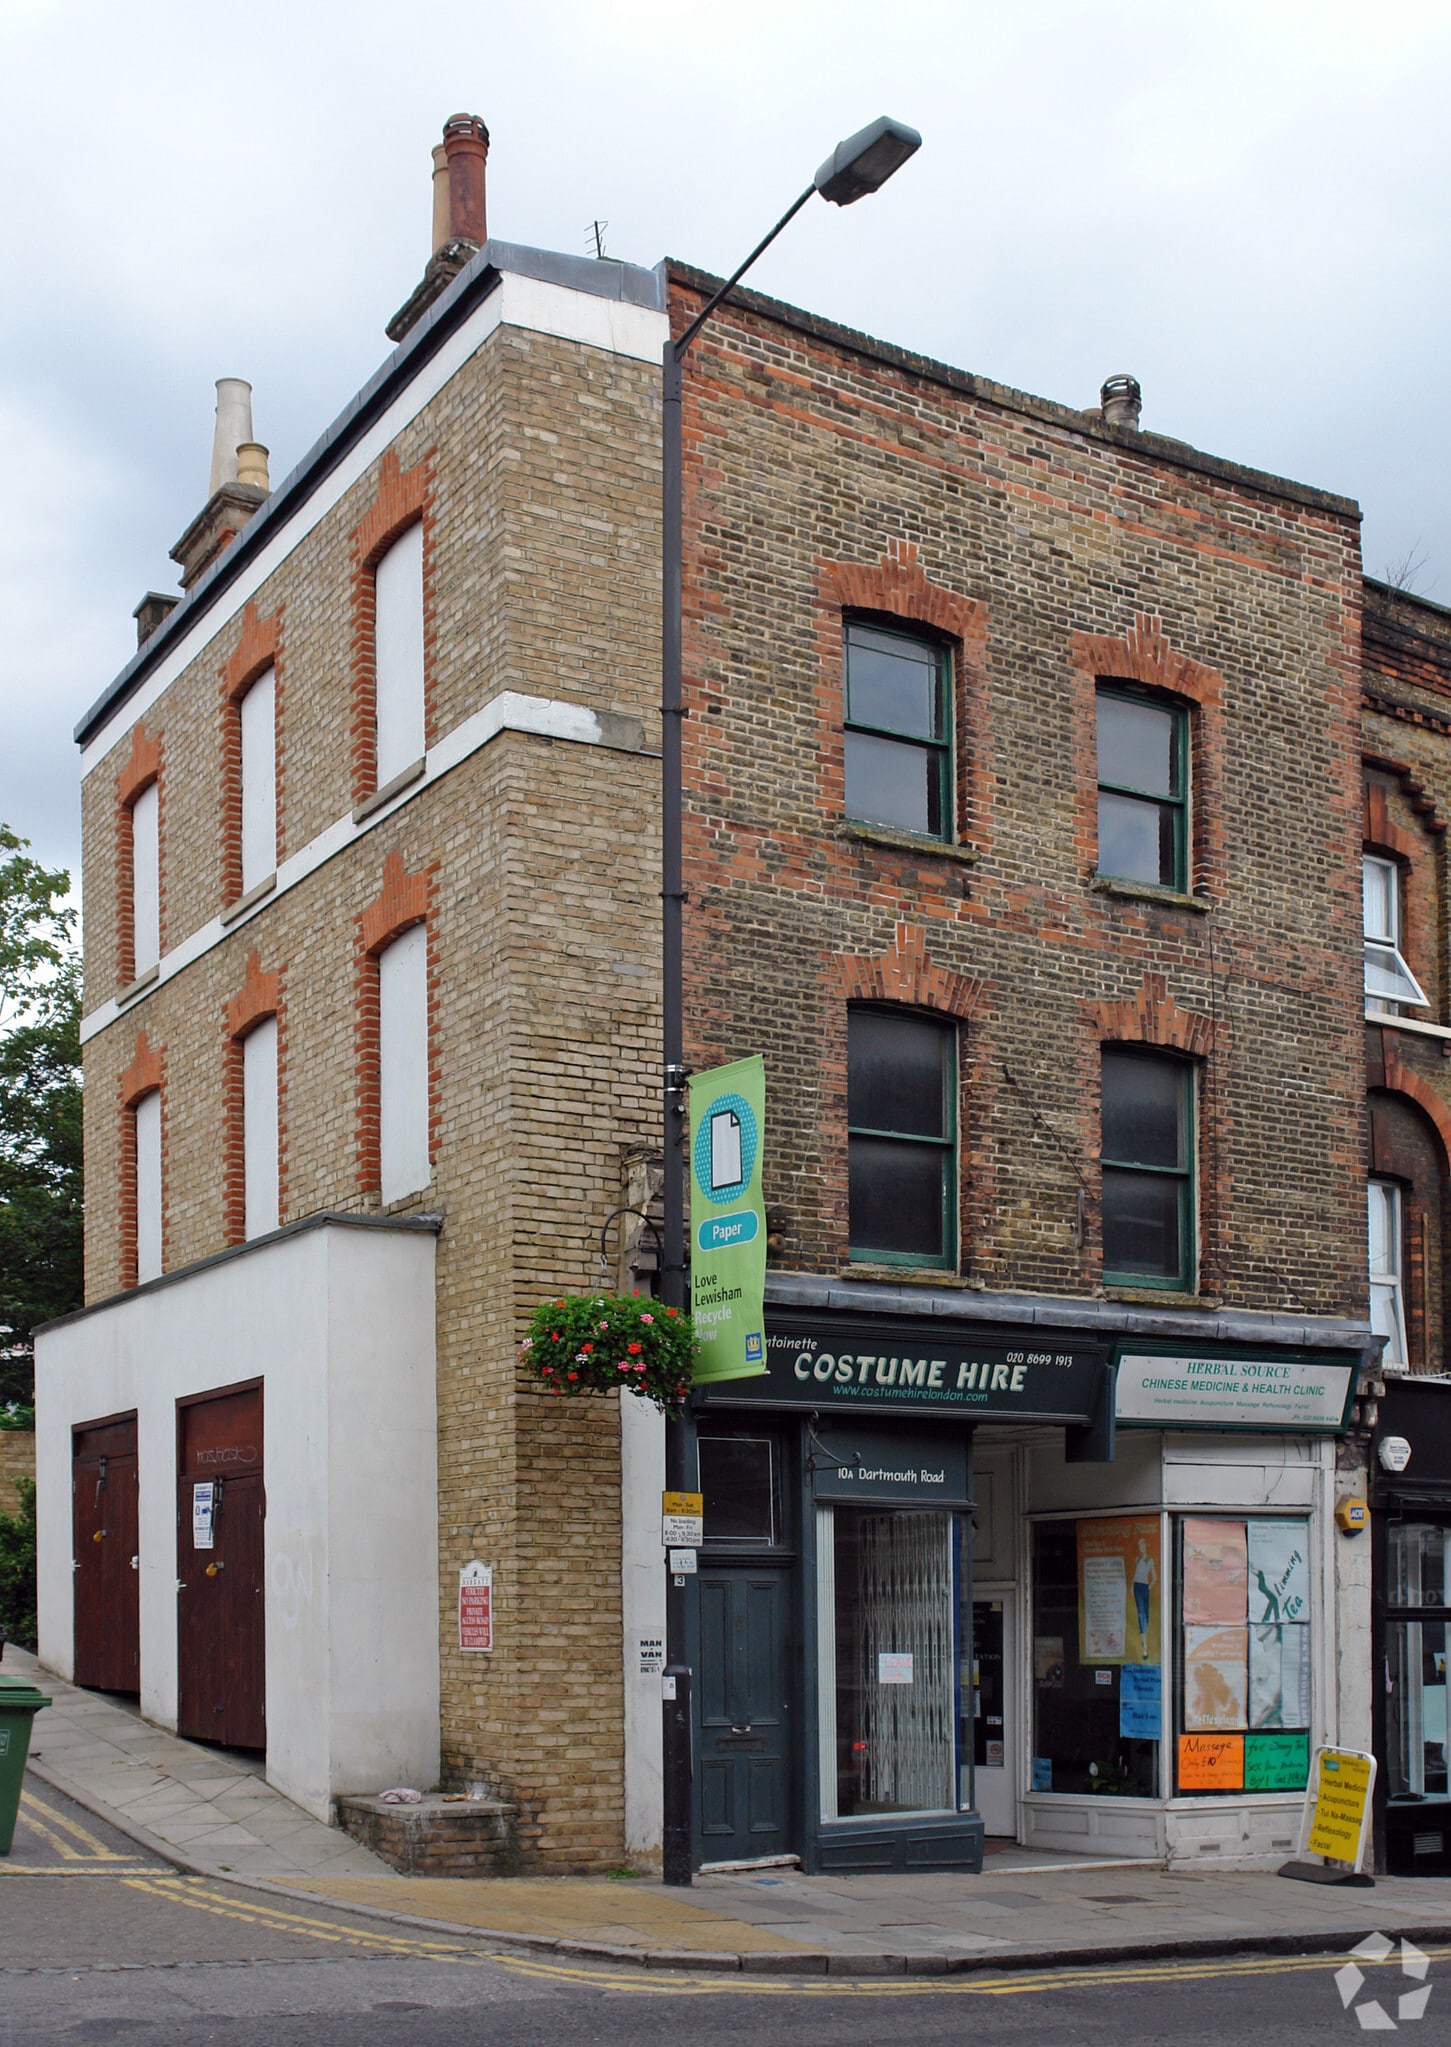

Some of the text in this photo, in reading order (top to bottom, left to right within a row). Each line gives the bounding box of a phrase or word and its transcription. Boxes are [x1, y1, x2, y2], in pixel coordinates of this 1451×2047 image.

[712, 1223, 743, 1242] Paper
[694, 1273, 718, 1289] Love
[694, 1287, 743, 1307] Lewisham
[694, 1305, 733, 1326] Recycle
[765, 1335, 818, 1350] ntoinette
[1006, 1352, 1073, 1368] 020 8699 1913
[794, 1352, 1028, 1392] COSTUME HIRE
[1186, 1362, 1291, 1379] HERBAL SOURCE
[833, 1384, 988, 1402] www.costumehirelondon.com
[1142, 1378, 1325, 1396] CHINESE MEDICINE & HEALTH CLINIC
[858, 1468, 917, 1484] Dartmouth
[921, 1469, 945, 1483] Road
[469, 1597, 489, 1605] PARKING
[1281, 1595, 1303, 1619] Tea
